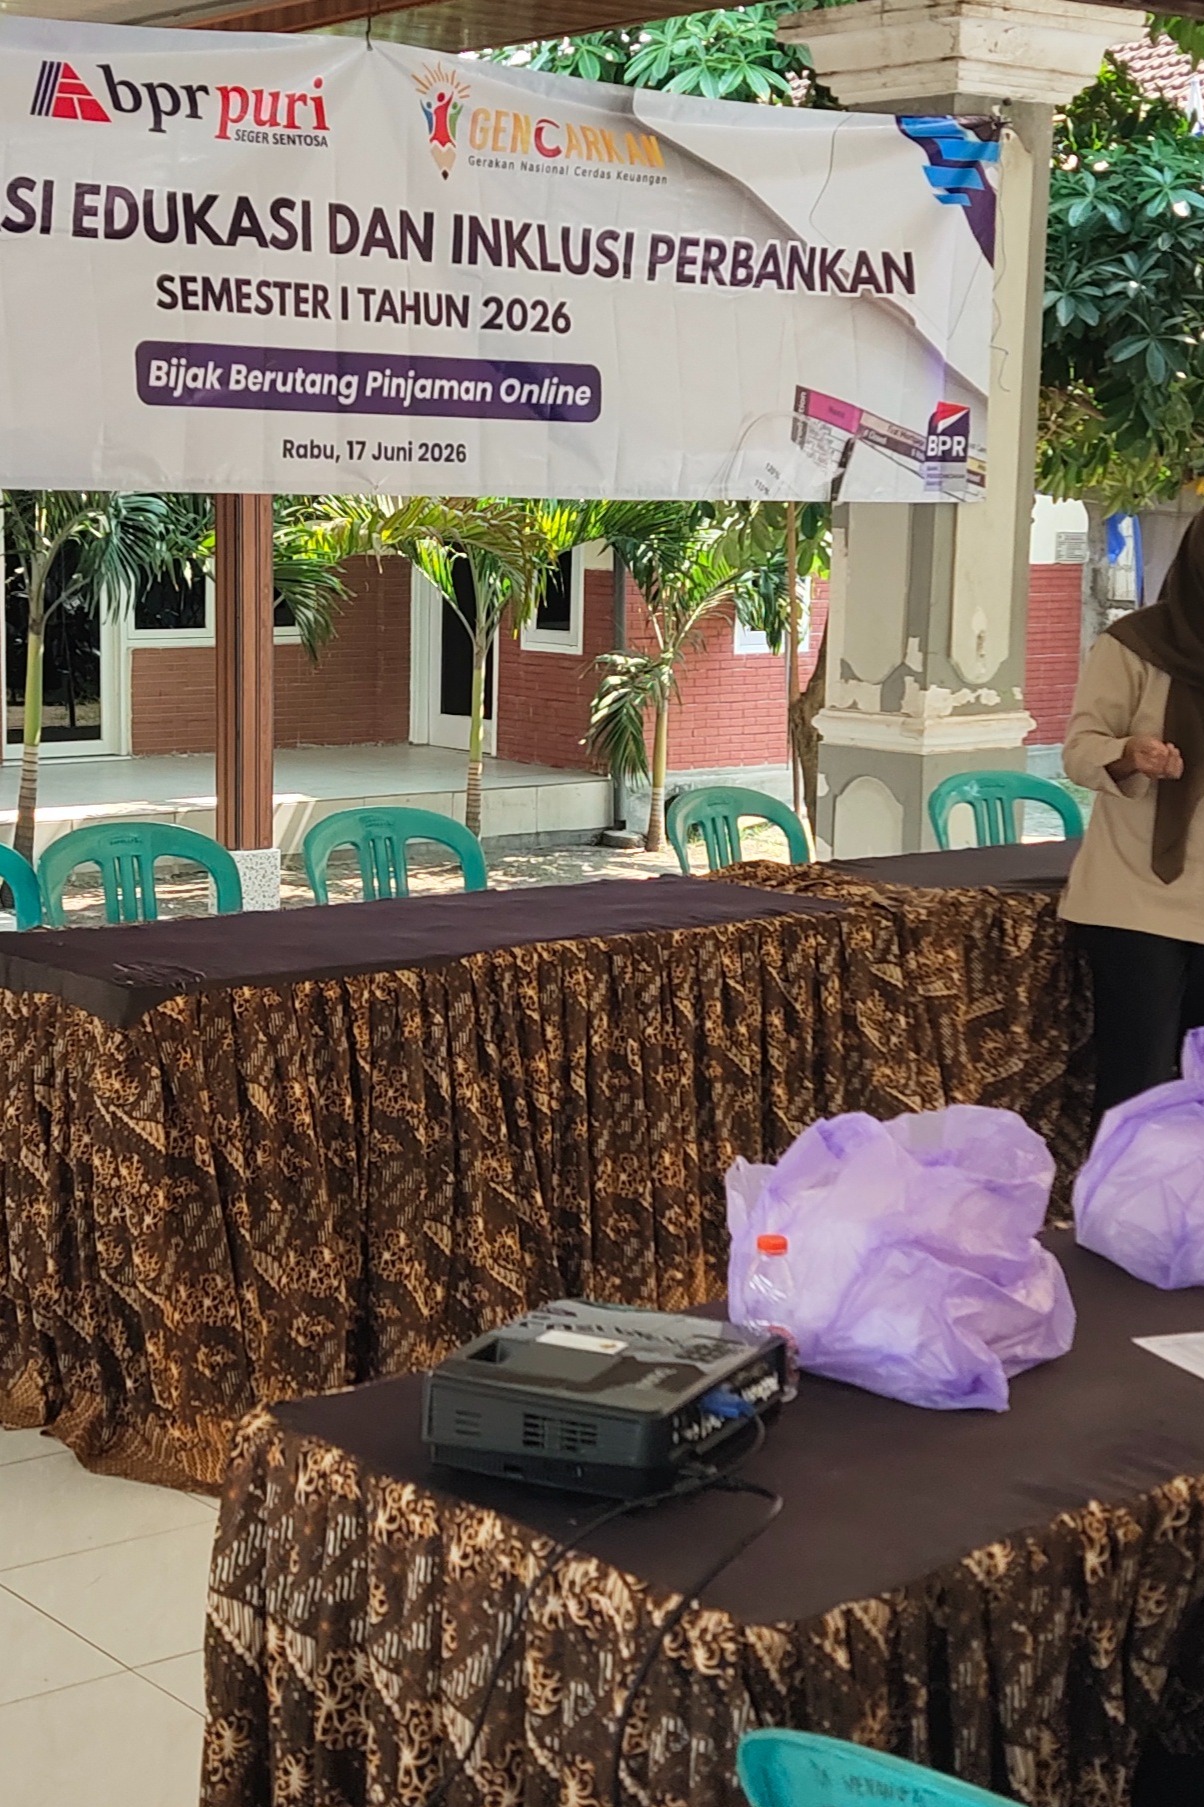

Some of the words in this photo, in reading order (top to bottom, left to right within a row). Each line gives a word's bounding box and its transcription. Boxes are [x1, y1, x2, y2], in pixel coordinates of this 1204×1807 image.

[97, 63, 209, 133] bpr
[214, 76, 330, 140] puri
[234, 129, 269, 145] SEGER
[271, 132, 328, 147] SENTOSA
[469, 108, 665, 168] GENCARKAN
[467, 155, 515, 170] Gerakan
[520, 161, 569, 176] Nasional
[574, 166, 611, 180] Cerdas
[616, 170, 668, 186] Keuangan
[0, 176, 53, 236] SI
[71, 181, 312, 253] EDUKASI
[328, 203, 434, 262] DAN
[452, 213, 634, 281] INKLUSI
[647, 235, 916, 295] PERBANKAN
[156, 273, 331, 320] SEMESTER
[340, 286, 349, 321] I
[357, 287, 470, 329] TAHUN
[480, 295, 572, 335] 2026
[148, 358, 222, 398] Bijak
[228, 361, 359, 405] Berutang
[365, 369, 493, 408] Pinjaman
[500, 376, 592, 407] Online
[282, 439, 341, 464] Rabu,
[346, 440, 366, 462] 17
[371, 440, 413, 463] Juni
[418, 442, 467, 464] 2026
[926, 435, 967, 457] BPR
